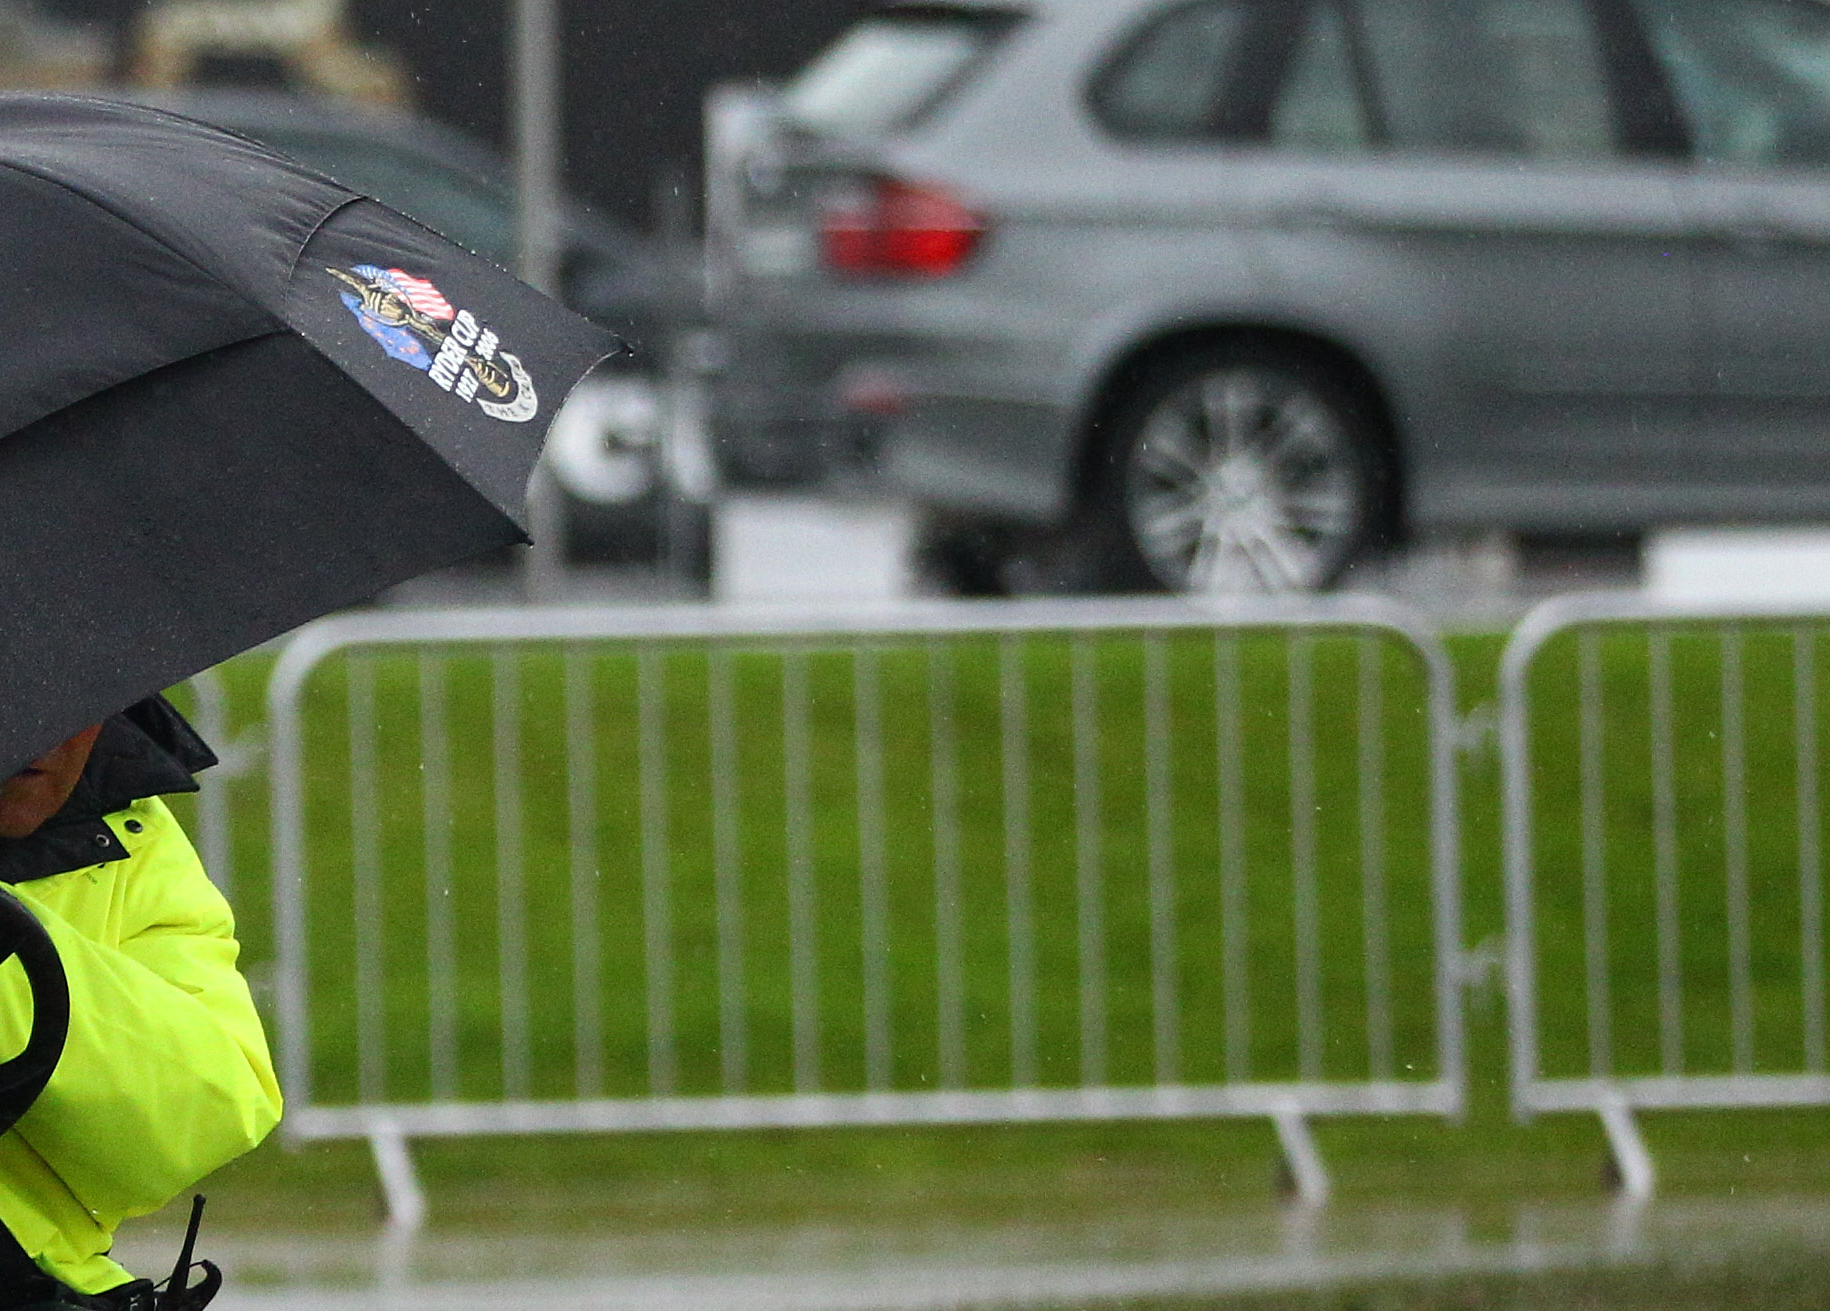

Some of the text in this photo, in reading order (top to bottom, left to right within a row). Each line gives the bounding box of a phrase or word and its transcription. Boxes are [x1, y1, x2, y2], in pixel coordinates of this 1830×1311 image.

[428, 309, 480, 392] RYDER CUP
[455, 368, 480, 403] 1927
